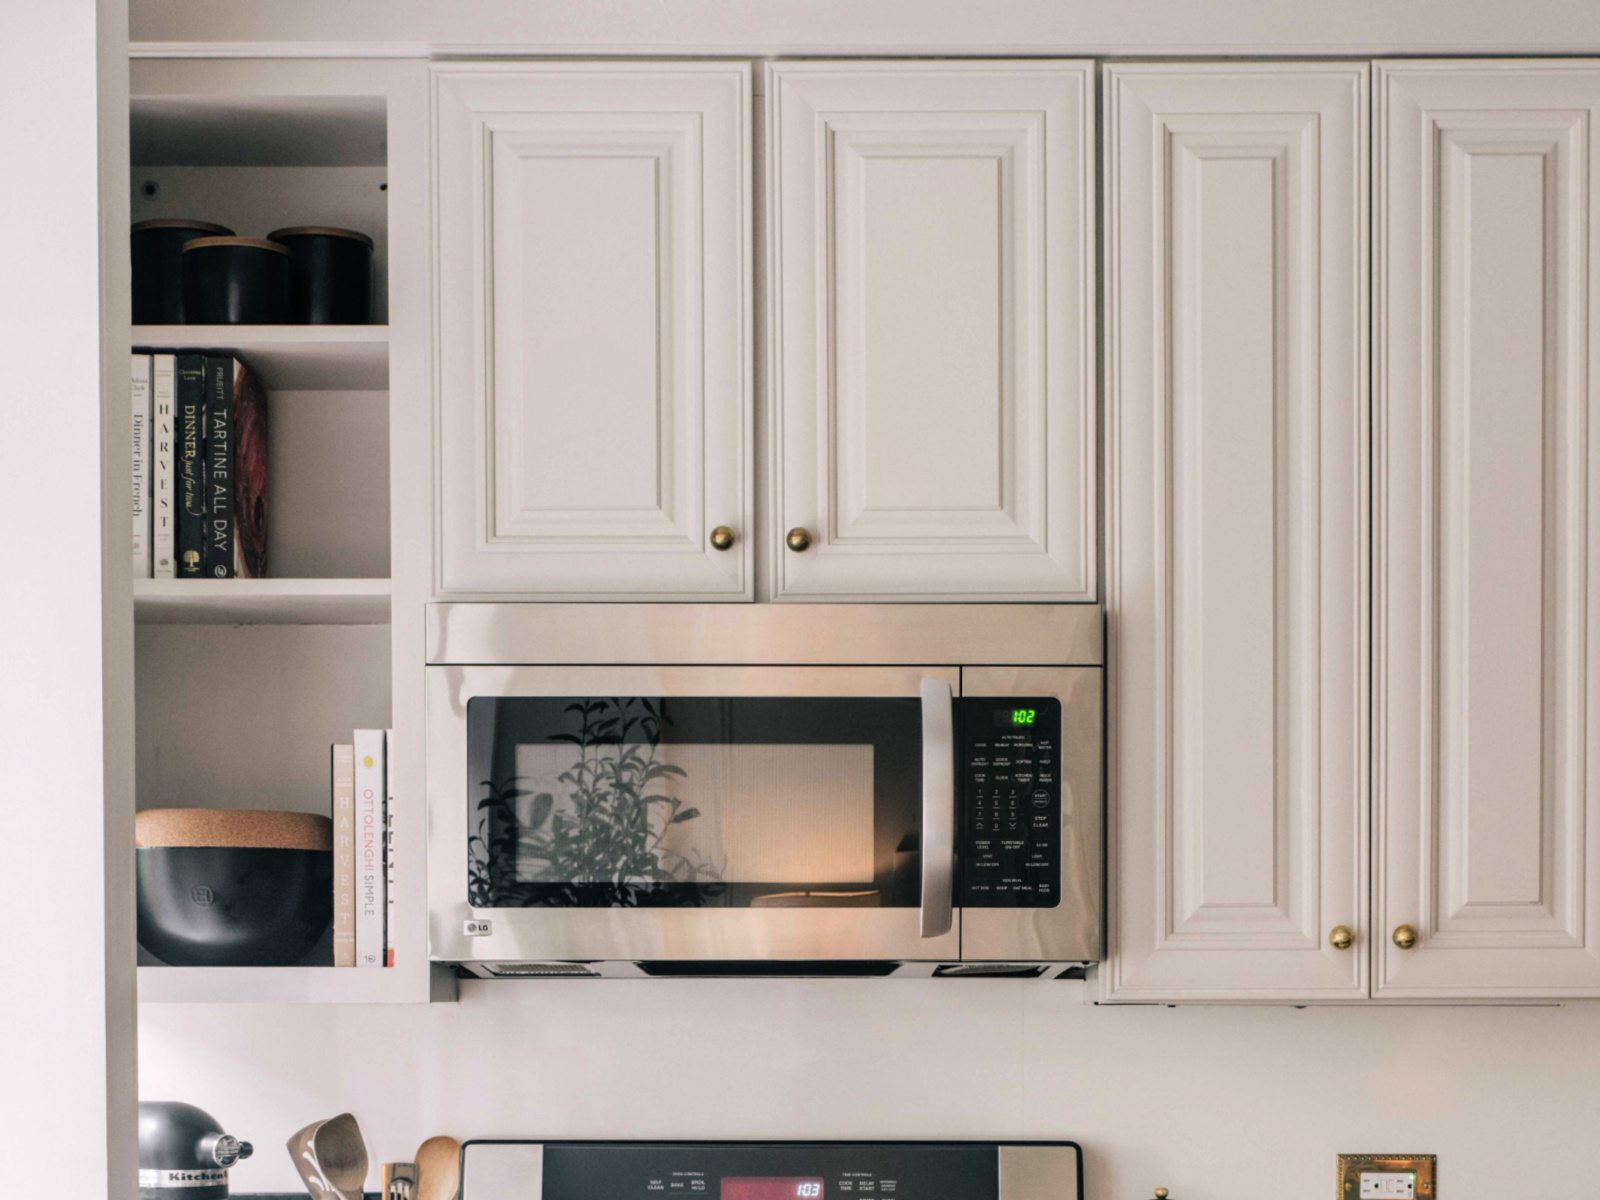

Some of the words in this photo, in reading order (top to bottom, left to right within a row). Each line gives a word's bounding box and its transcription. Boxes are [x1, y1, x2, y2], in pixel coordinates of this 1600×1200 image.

[216, 367, 224, 400] PRUEITT
[133, 414, 144, 456] Dinner
[184, 405, 196, 459] DINNER
[213, 408, 228, 479] TARTINE
[133, 460, 144, 471] in
[159, 404, 169, 527] HARVEST
[180, 456, 194, 476] just
[180, 473, 196, 491] for
[132, 475, 144, 516] French
[213, 484, 228, 514] ALL
[213, 520, 228, 551] DAY
[363, 788, 374, 871] OTTOLENGHI
[339, 797, 350, 925] HARVEST
[364, 875, 375, 917] SIMPLE
[797, 1183, 820, 1197] 1:03
